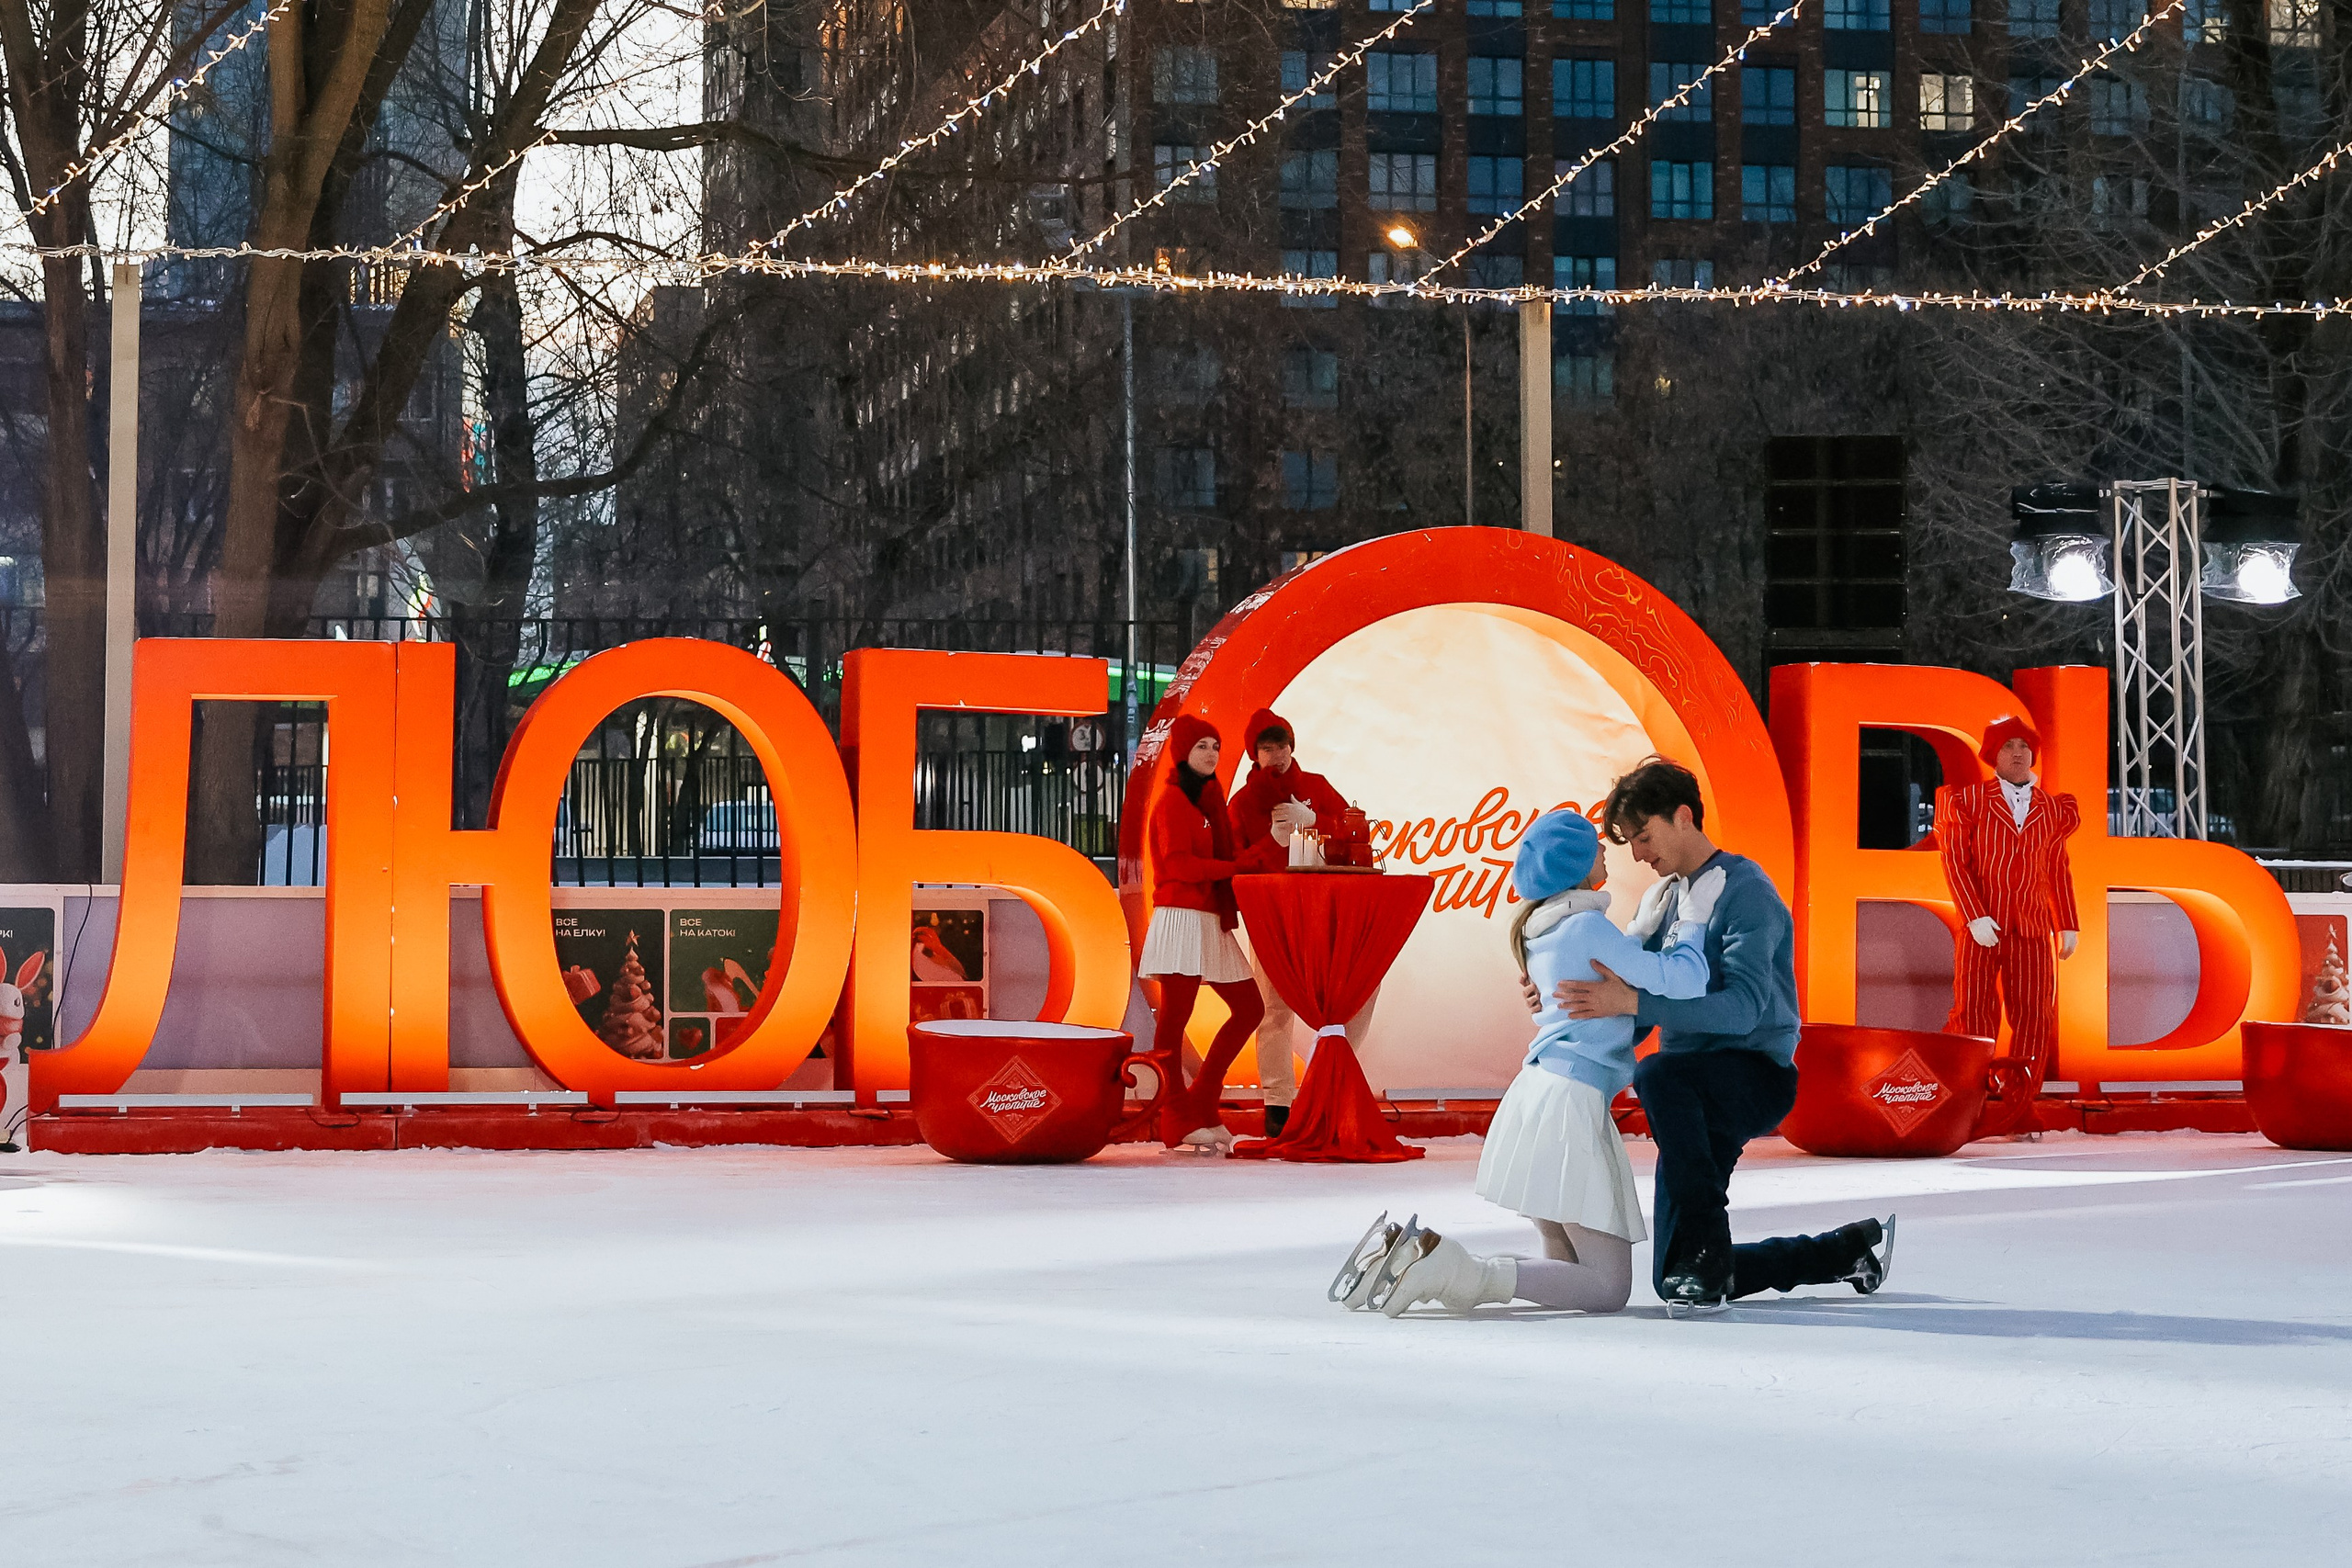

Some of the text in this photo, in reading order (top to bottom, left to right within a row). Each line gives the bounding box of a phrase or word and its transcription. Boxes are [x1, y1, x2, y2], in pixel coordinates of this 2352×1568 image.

[29, 526, 2301, 1114] ЛЮБОВЬ
[556, 918, 578, 927] ВСЕ
[679, 918, 702, 927] ВСЕ
[555, 929, 606, 937] НА ЕЛКУ!
[680, 929, 736, 937] НА КАТОК!
